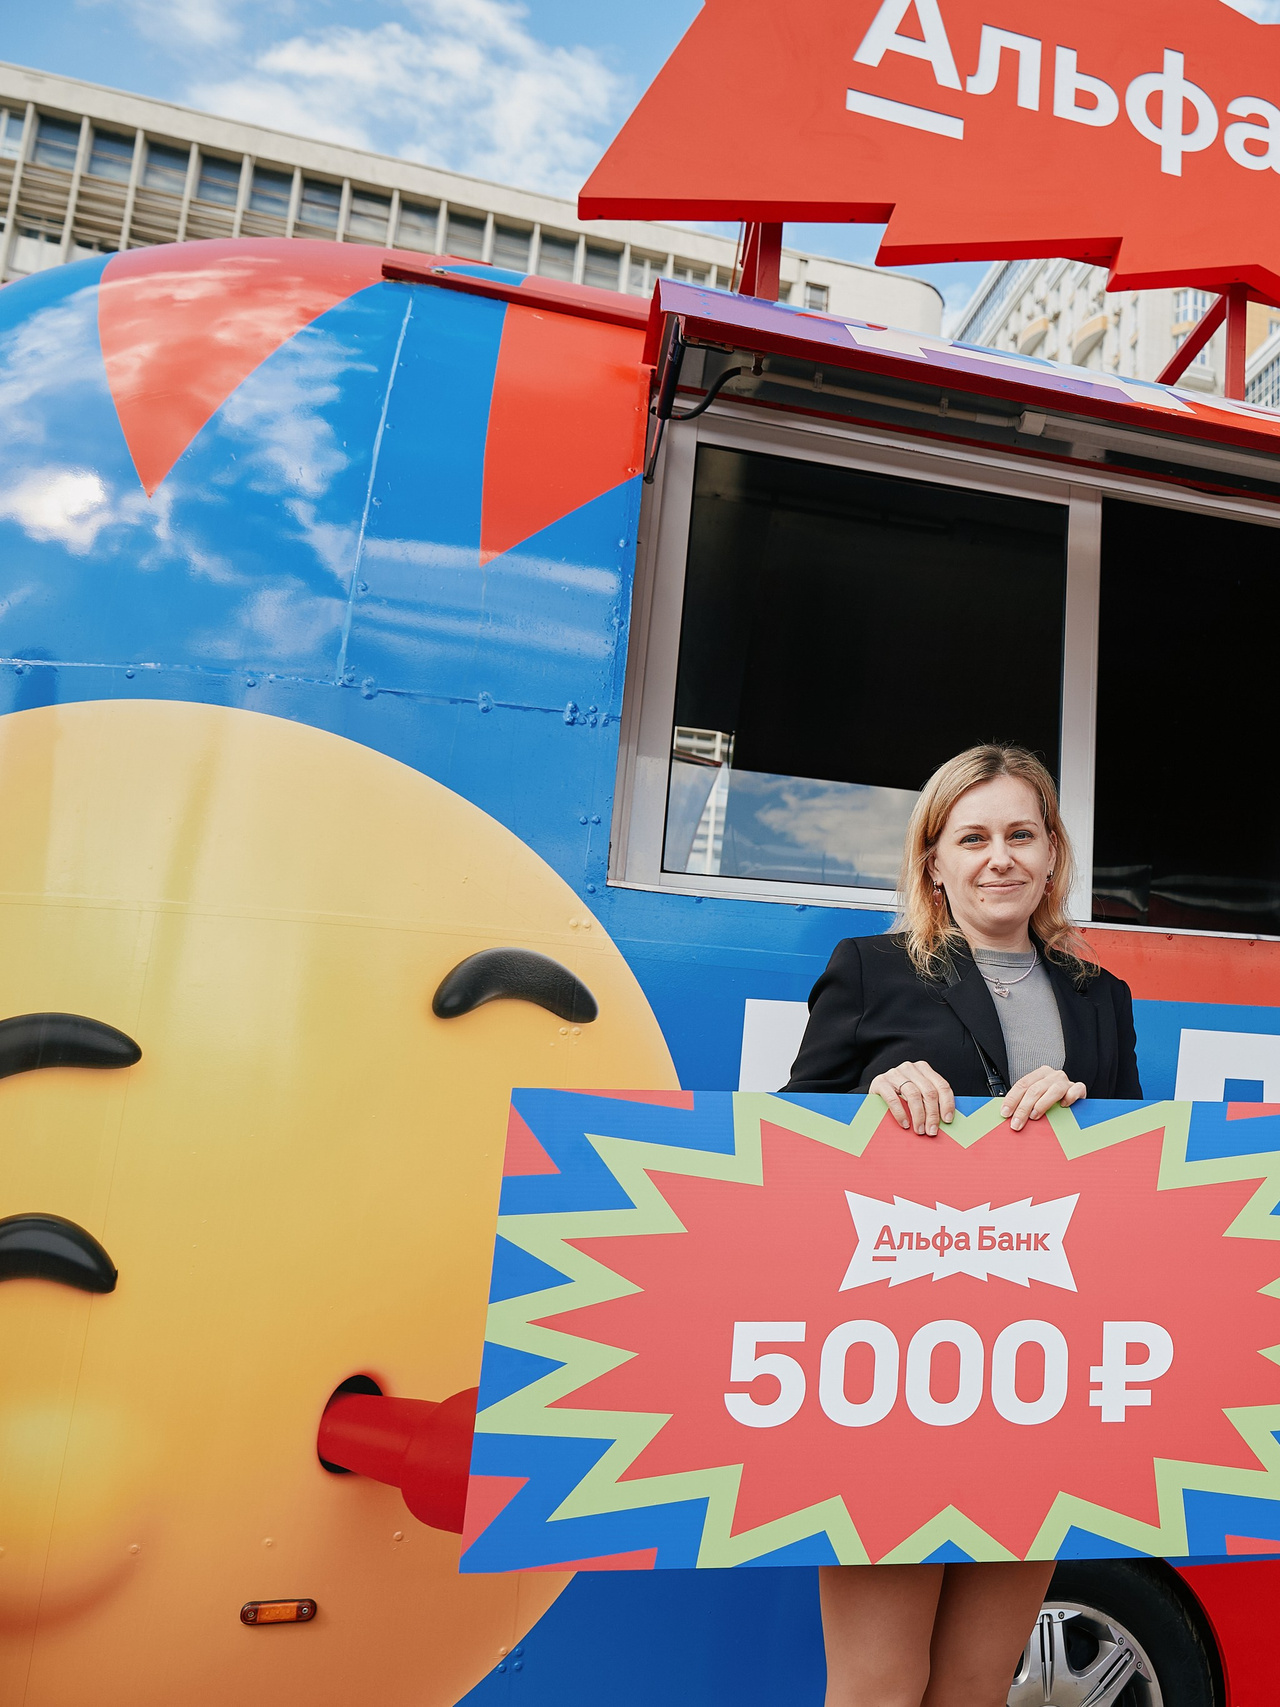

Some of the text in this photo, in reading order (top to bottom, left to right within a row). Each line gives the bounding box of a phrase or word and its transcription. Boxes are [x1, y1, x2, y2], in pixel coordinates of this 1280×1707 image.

[872, 1225, 1050, 1258] Альфа Банк
[723, 1319, 1069, 1428] 5000
